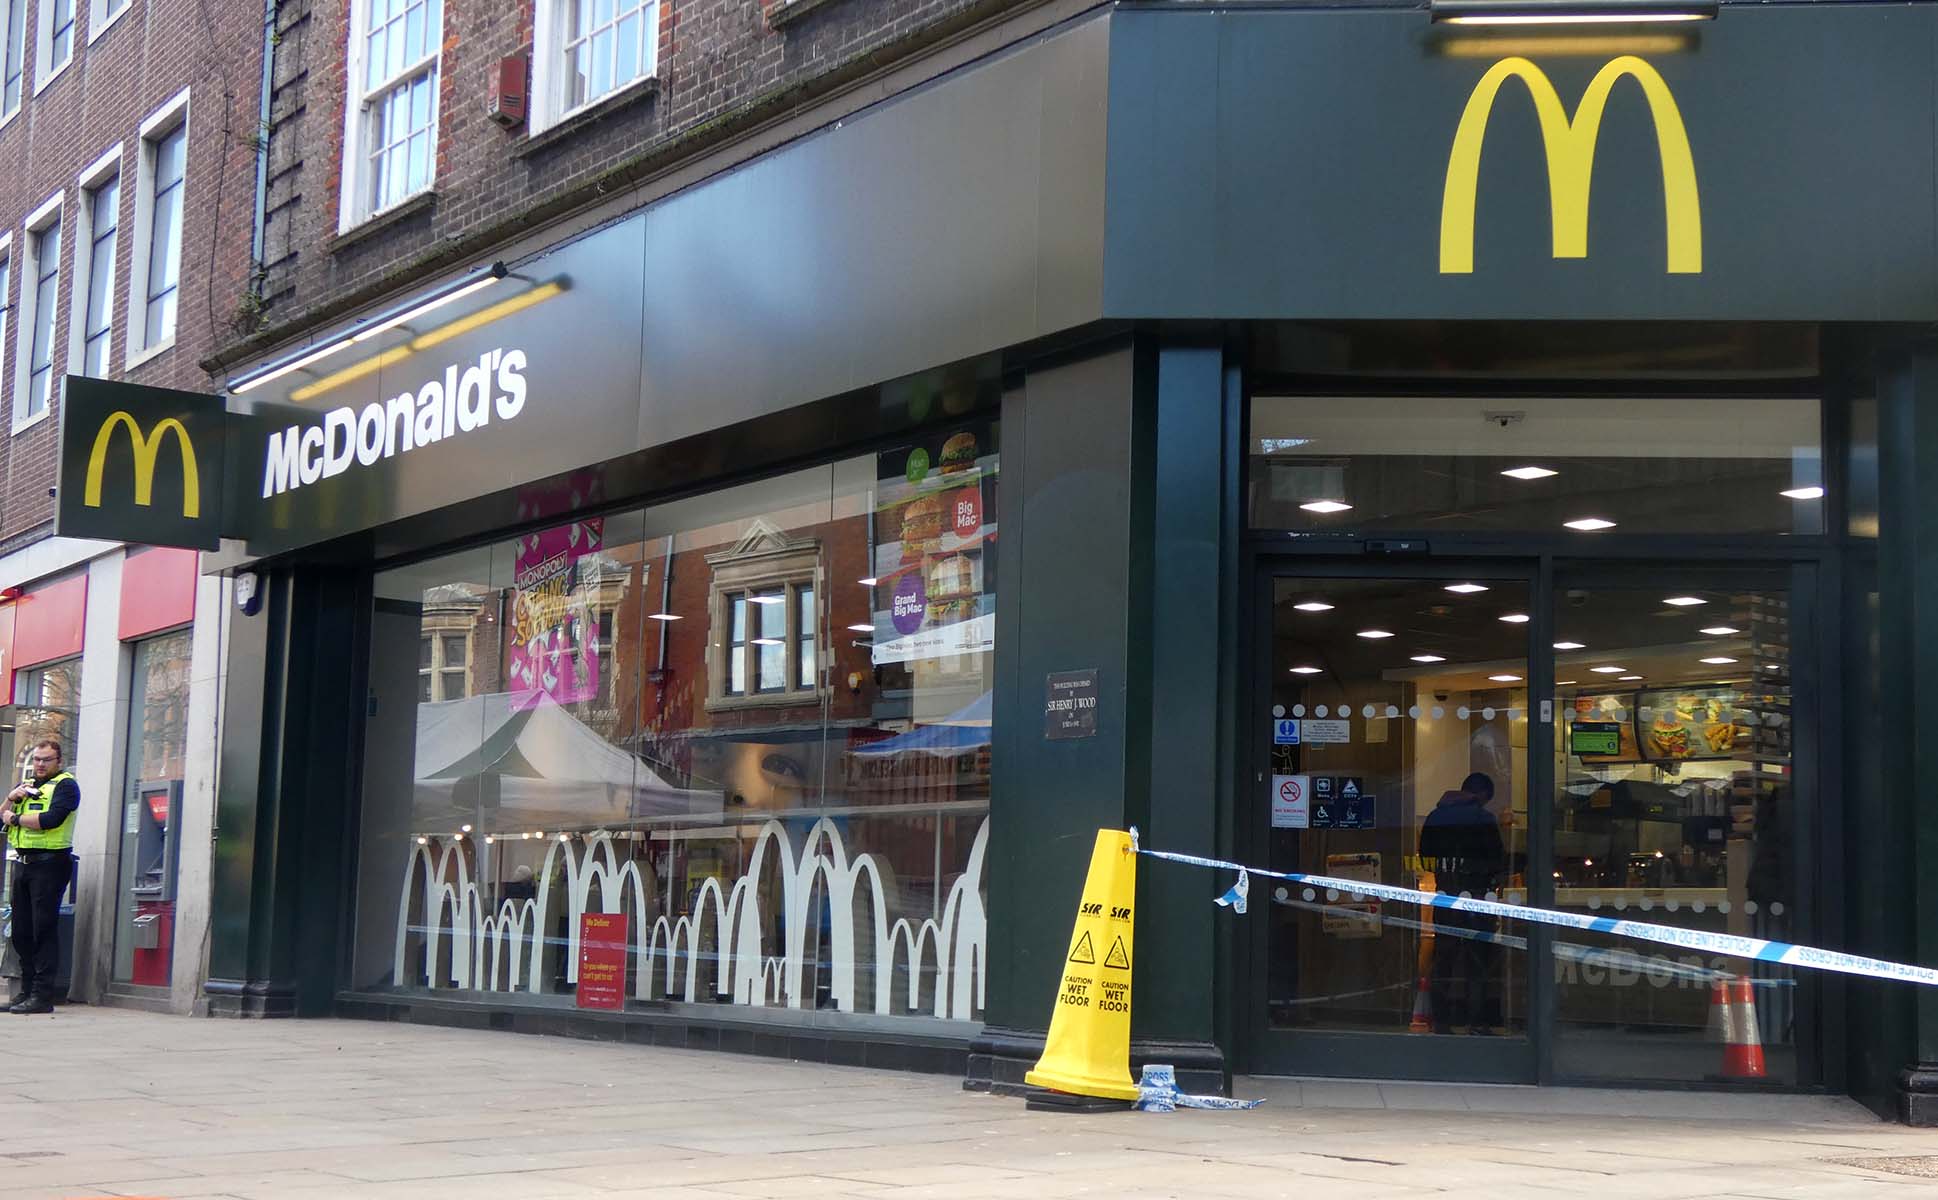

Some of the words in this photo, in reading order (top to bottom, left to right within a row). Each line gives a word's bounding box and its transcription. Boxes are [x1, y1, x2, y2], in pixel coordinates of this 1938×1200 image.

[262, 348, 527, 499] McDonald's
[957, 501, 973, 516] Big
[957, 514, 977, 528] Mac
[519, 554, 567, 590] MONOPOLY
[894, 592, 917, 606] Grand
[894, 604, 907, 617] Big
[907, 604, 923, 614] Mac
[1391, 890, 1422, 903] POLICE
[1081, 903, 1102, 915] SIR
[1110, 907, 1131, 920] SIR
[1624, 923, 1656, 940] CROSS
[1658, 928, 1677, 943] NOT
[1680, 931, 1694, 946] DO
[1695, 933, 1716, 949] LINE
[1718, 937, 1753, 953] POLICE
[1798, 947, 1833, 965] CROSS
[1065, 976, 1093, 985] CAUTION
[1101, 981, 1129, 991] CAUTION
[1067, 984, 1088, 995] WET
[1105, 990, 1125, 1001] WET
[1060, 994, 1090, 1007] FLOOR
[1099, 1000, 1129, 1013] FLOOR
